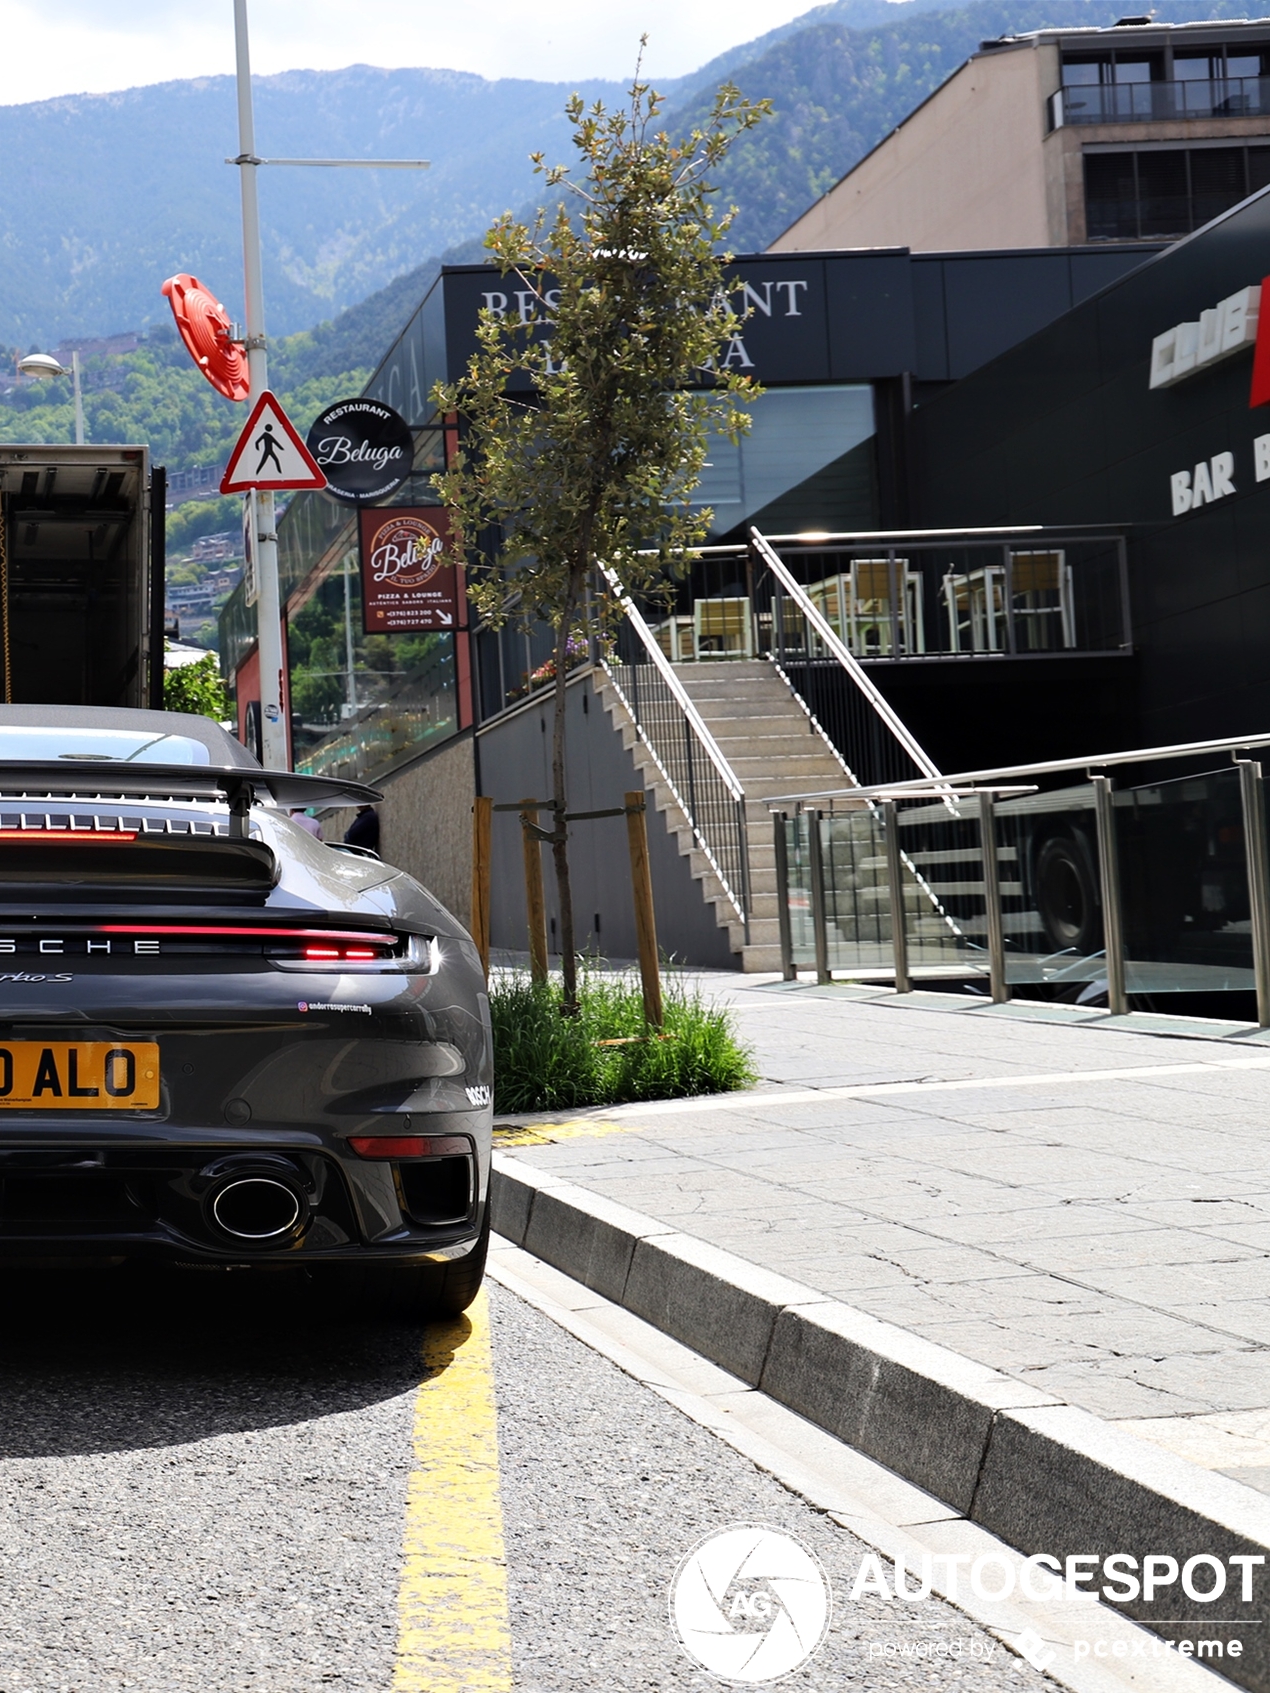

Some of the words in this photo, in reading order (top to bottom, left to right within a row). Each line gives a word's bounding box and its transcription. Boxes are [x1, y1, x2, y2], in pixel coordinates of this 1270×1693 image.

[482, 281, 808, 326] RESANT
[1149, 286, 1262, 390] CLUB
[323, 403, 392, 425] RESTAURANT
[317, 436, 404, 471] Beluga
[359, 478, 401, 498] MARISQUERIA
[1170, 451, 1238, 516] BAR
[378, 524, 396, 540] PIZZA
[403, 520, 431, 535] LOUNGE
[390, 575, 398, 583] IL
[416, 564, 437, 583] SPAZIO
[308, 1002, 372, 1016] andorrasupercarrally
[31, 1048, 136, 1097] ALO
[464, 1085, 491, 1106] BOSCH
